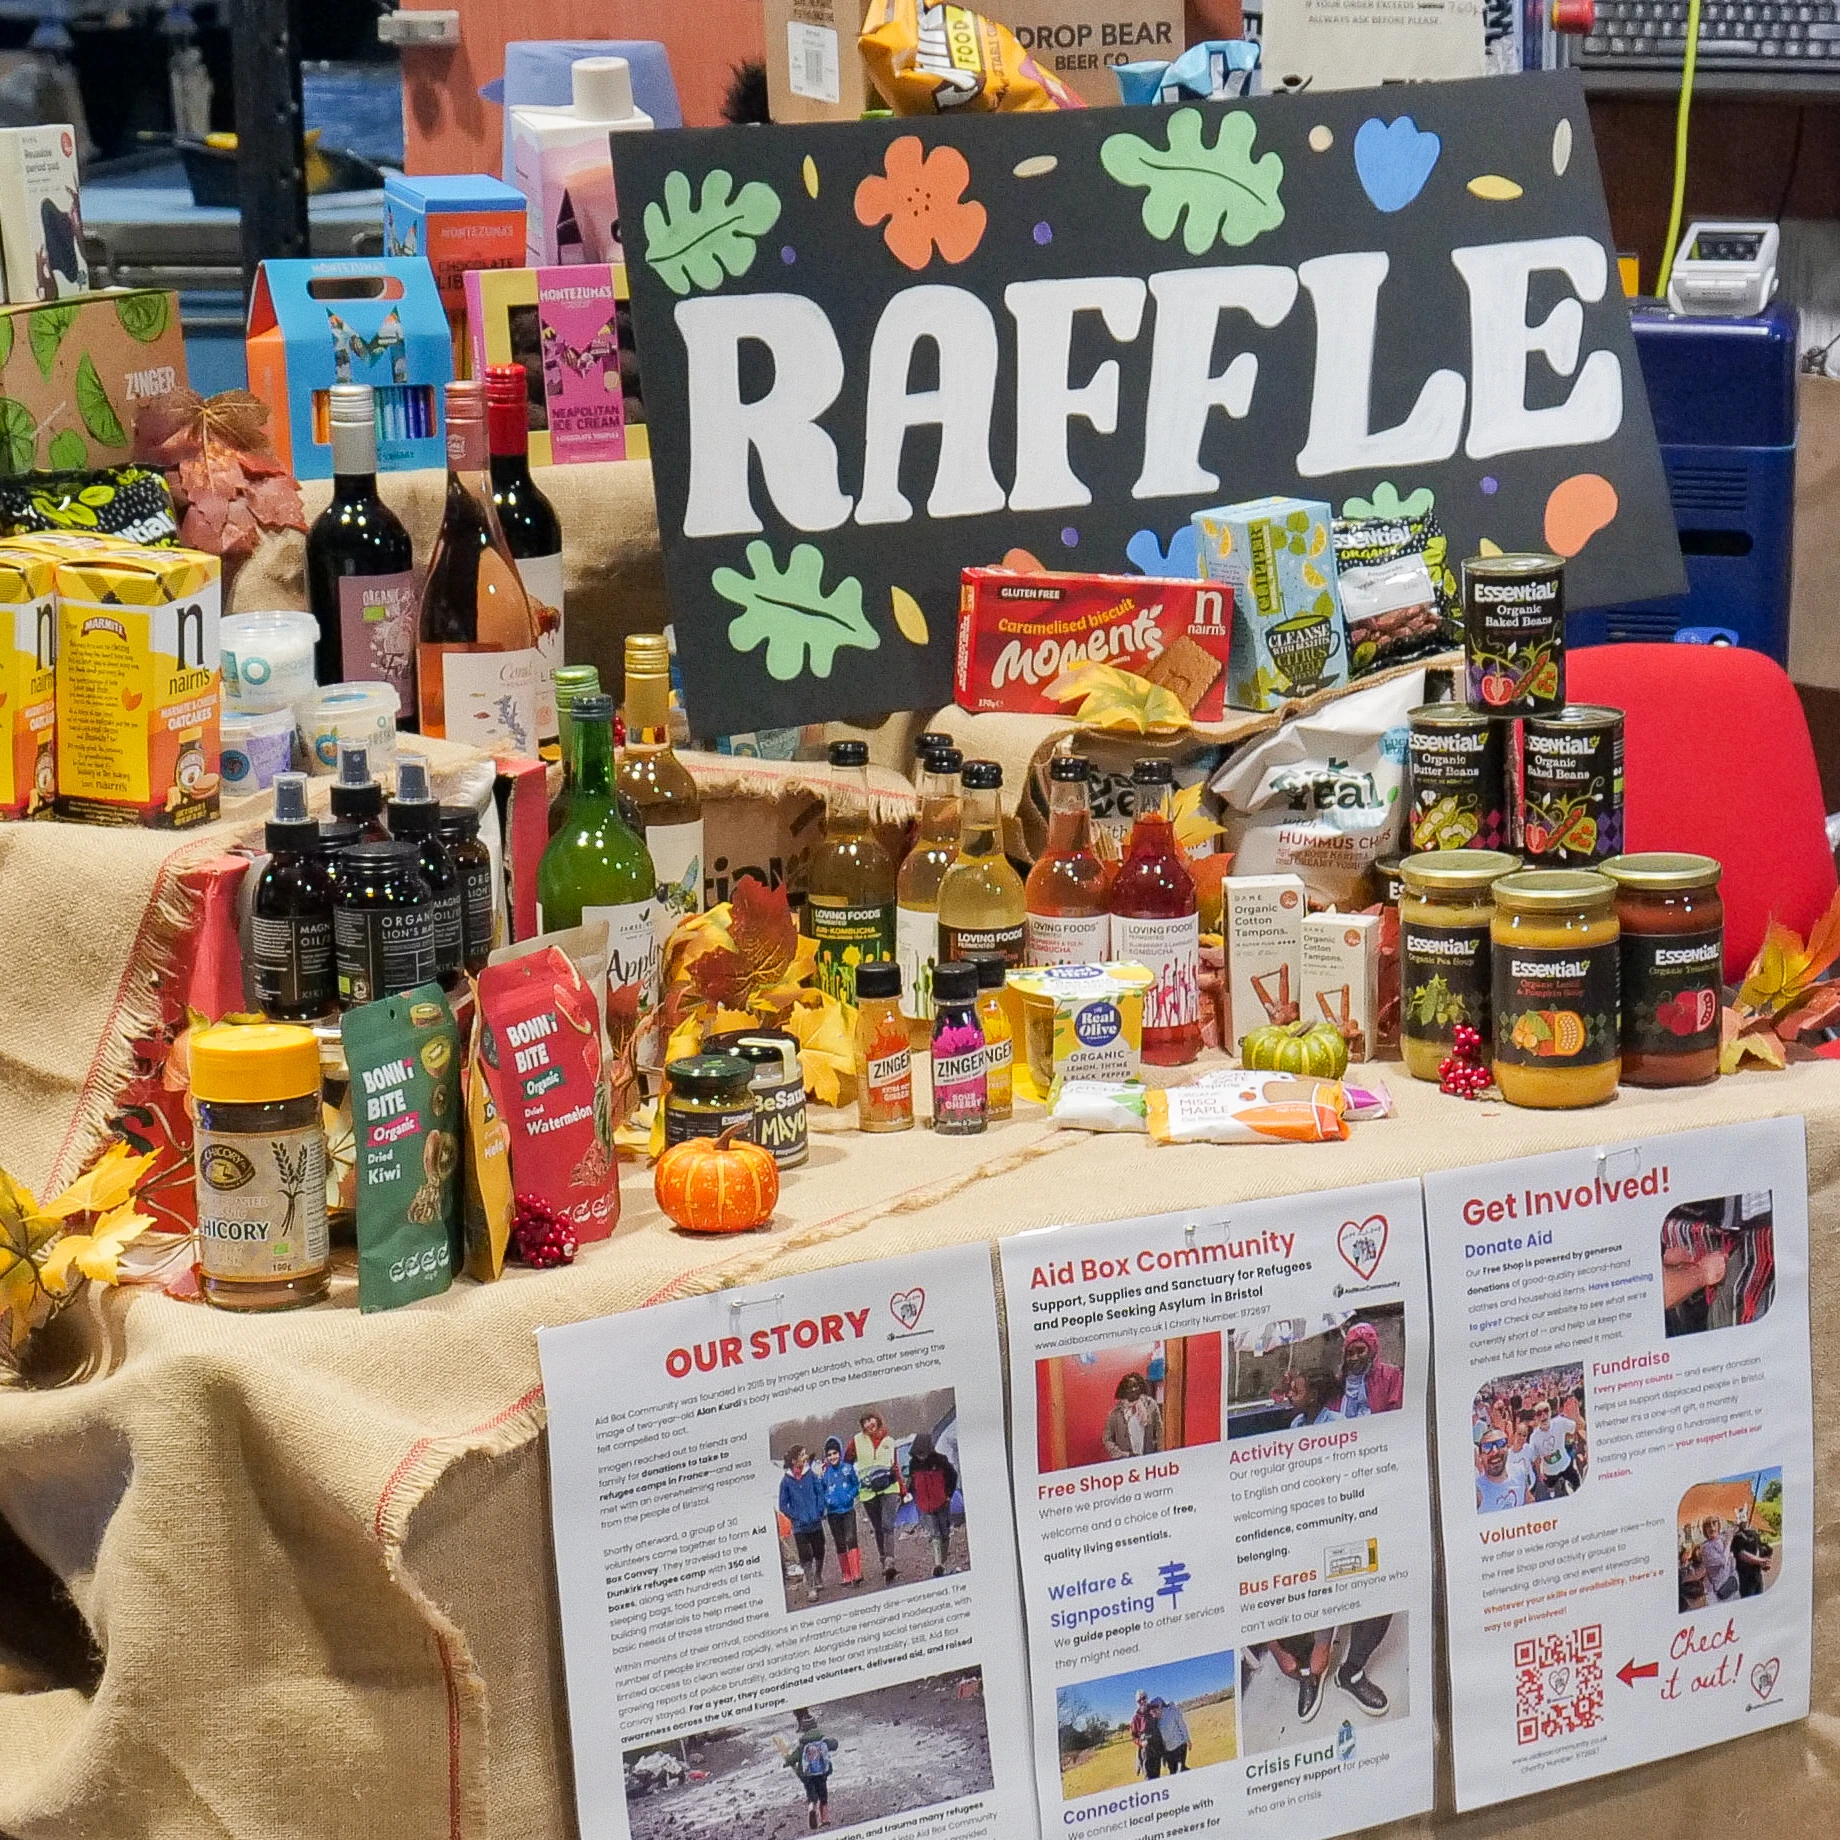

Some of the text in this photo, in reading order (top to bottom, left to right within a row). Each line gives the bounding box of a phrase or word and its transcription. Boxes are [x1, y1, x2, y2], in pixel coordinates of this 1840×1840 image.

[952, 20, 977, 65] FOOD
[1015, 21, 1172, 49] DROP BEAR
[1055, 53, 1099, 71] BEER
[673, 234, 1624, 538] RAFFLE
[552, 416, 621, 431] ICE CREAM
[1332, 525, 1412, 549] ssential
[1251, 524, 1271, 613] CLIPPER
[1001, 587, 1061, 600] GLUTEN FREE
[998, 597, 1137, 636] Caramelised biscuit
[1194, 589, 1224, 626] n
[1496, 605, 1542, 618] Organic
[1485, 615, 1553, 628] Baked Beans
[176, 603, 205, 673] n
[1422, 753, 1466, 768] Organic
[1445, 765, 1479, 777] Beans
[1535, 754, 1577, 769] Organic
[1556, 768, 1590, 780] Beans
[1279, 830, 1354, 850] HUMMUS
[815, 909, 881, 920] LOVING FOODS
[1234, 903, 1278, 916] Organic
[1234, 917, 1272, 926] Cotton
[957, 927, 1023, 943] LOVING FOODS
[1063, 923, 1096, 934] FOODS
[1128, 922, 1193, 934] LOVING FOODS
[1235, 928, 1289, 938] Tampons.
[1303, 934, 1336, 945] Organic
[1079, 1021, 1117, 1037] Olive
[1081, 1008, 1115, 1026] Real
[514, 1043, 551, 1074] BITE
[1070, 1050, 1125, 1063] ORGANIC
[525, 1069, 561, 1097] Organic
[366, 1088, 408, 1122] BITE
[524, 1104, 546, 1119] Dried
[944, 1098, 983, 1110] CHERRY
[1179, 1098, 1217, 1107] MISO
[1180, 1105, 1229, 1116] MAPLE
[372, 1116, 417, 1143] Organic
[525, 1102, 594, 1137] Watermelon
[761, 1108, 806, 1146] MAYO
[366, 1148, 394, 1165] Dried
[367, 1166, 402, 1186] Kiwi
[1463, 1165, 1671, 1227] Get Involved!
[1464, 1229, 1553, 1260] Donate Aid
[1030, 1228, 1298, 1290] Aid Box Community
[1032, 1259, 1313, 1313] Support, Supplies and Sanctuary for Refugees
[1033, 1284, 1264, 1332] and People Seeking Asylum in Bristol
[1168, 1315, 1201, 1333] Charity
[665, 1307, 871, 1379] OUR STORY
[1592, 1349, 1671, 1377] Fundraise
[628, 1398, 680, 1422] Community
[696, 1403, 719, 1417] Alan
[1229, 1428, 1359, 1466] Activity Groups
[1037, 1462, 1181, 1500] Free Shop & Hub
[1235, 1506, 1379, 1544] confidence, community, and
[1479, 1518, 1559, 1546] Volunteer
[1043, 1530, 1172, 1564] quality living essentials.
[1236, 1545, 1291, 1566] belonging.
[1047, 1571, 1134, 1603] Welfare &
[1239, 1567, 1318, 1598] Bus Fares
[1050, 1594, 1156, 1631] Signposting
[1072, 1622, 1141, 1648] guide people
[1670, 1618, 1741, 1660] Check
[1691, 1653, 1744, 1690] out!
[620, 1723, 672, 1744] awareness
[1245, 1744, 1335, 1781] Crisis Fund
[1246, 1764, 1342, 1798] Emergency support
[1063, 1785, 1171, 1826] Connections
